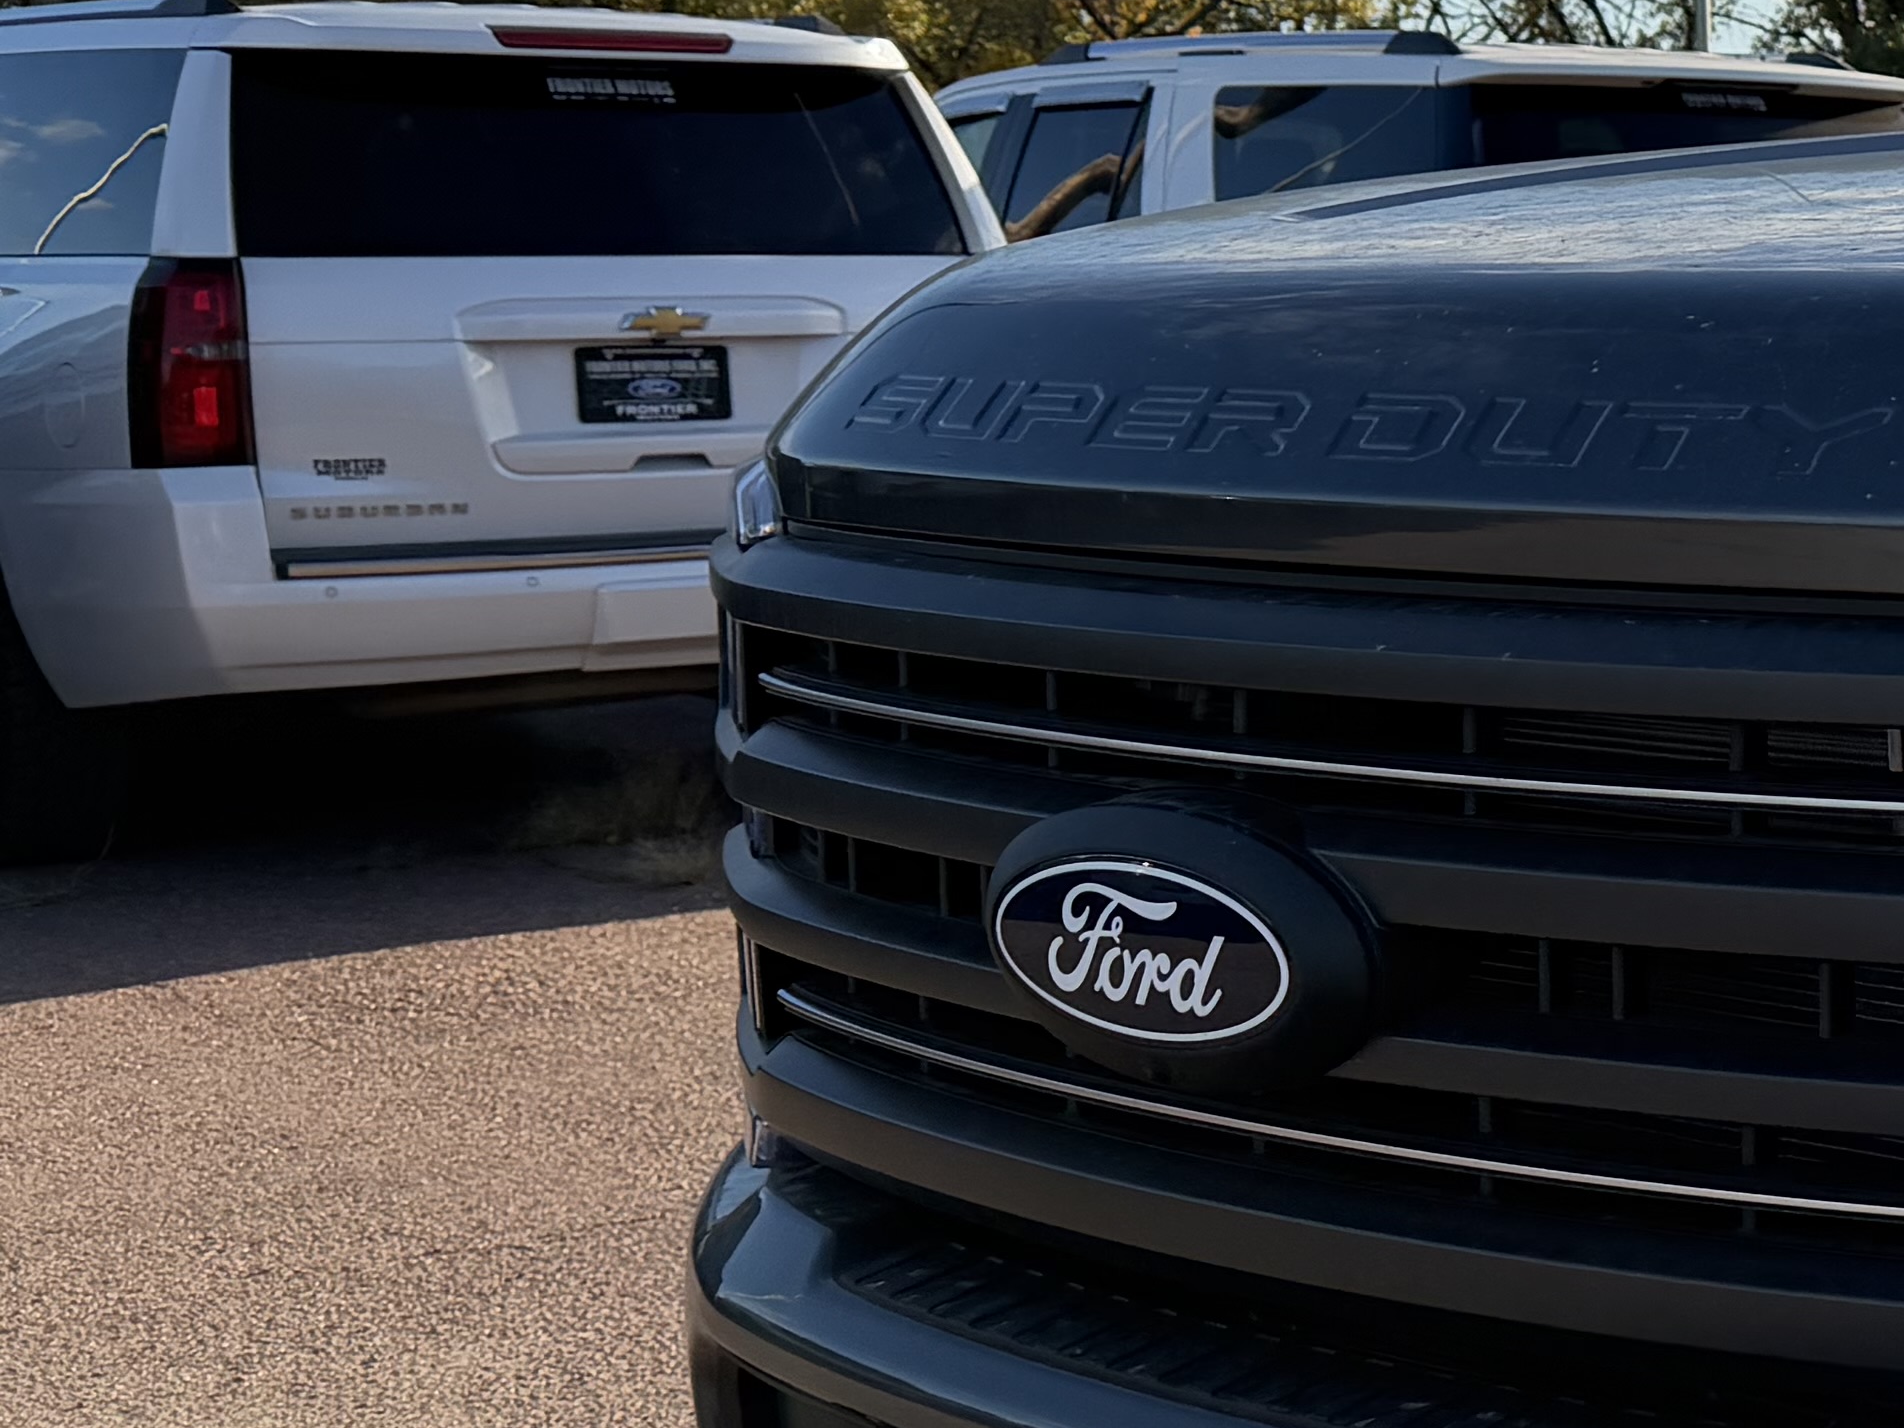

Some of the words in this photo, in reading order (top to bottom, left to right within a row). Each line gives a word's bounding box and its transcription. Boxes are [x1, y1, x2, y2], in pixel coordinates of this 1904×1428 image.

[844, 373, 1312, 460] SUPER
[1322, 389, 1896, 477] DUTY
[1045, 880, 1228, 1020] Ford
